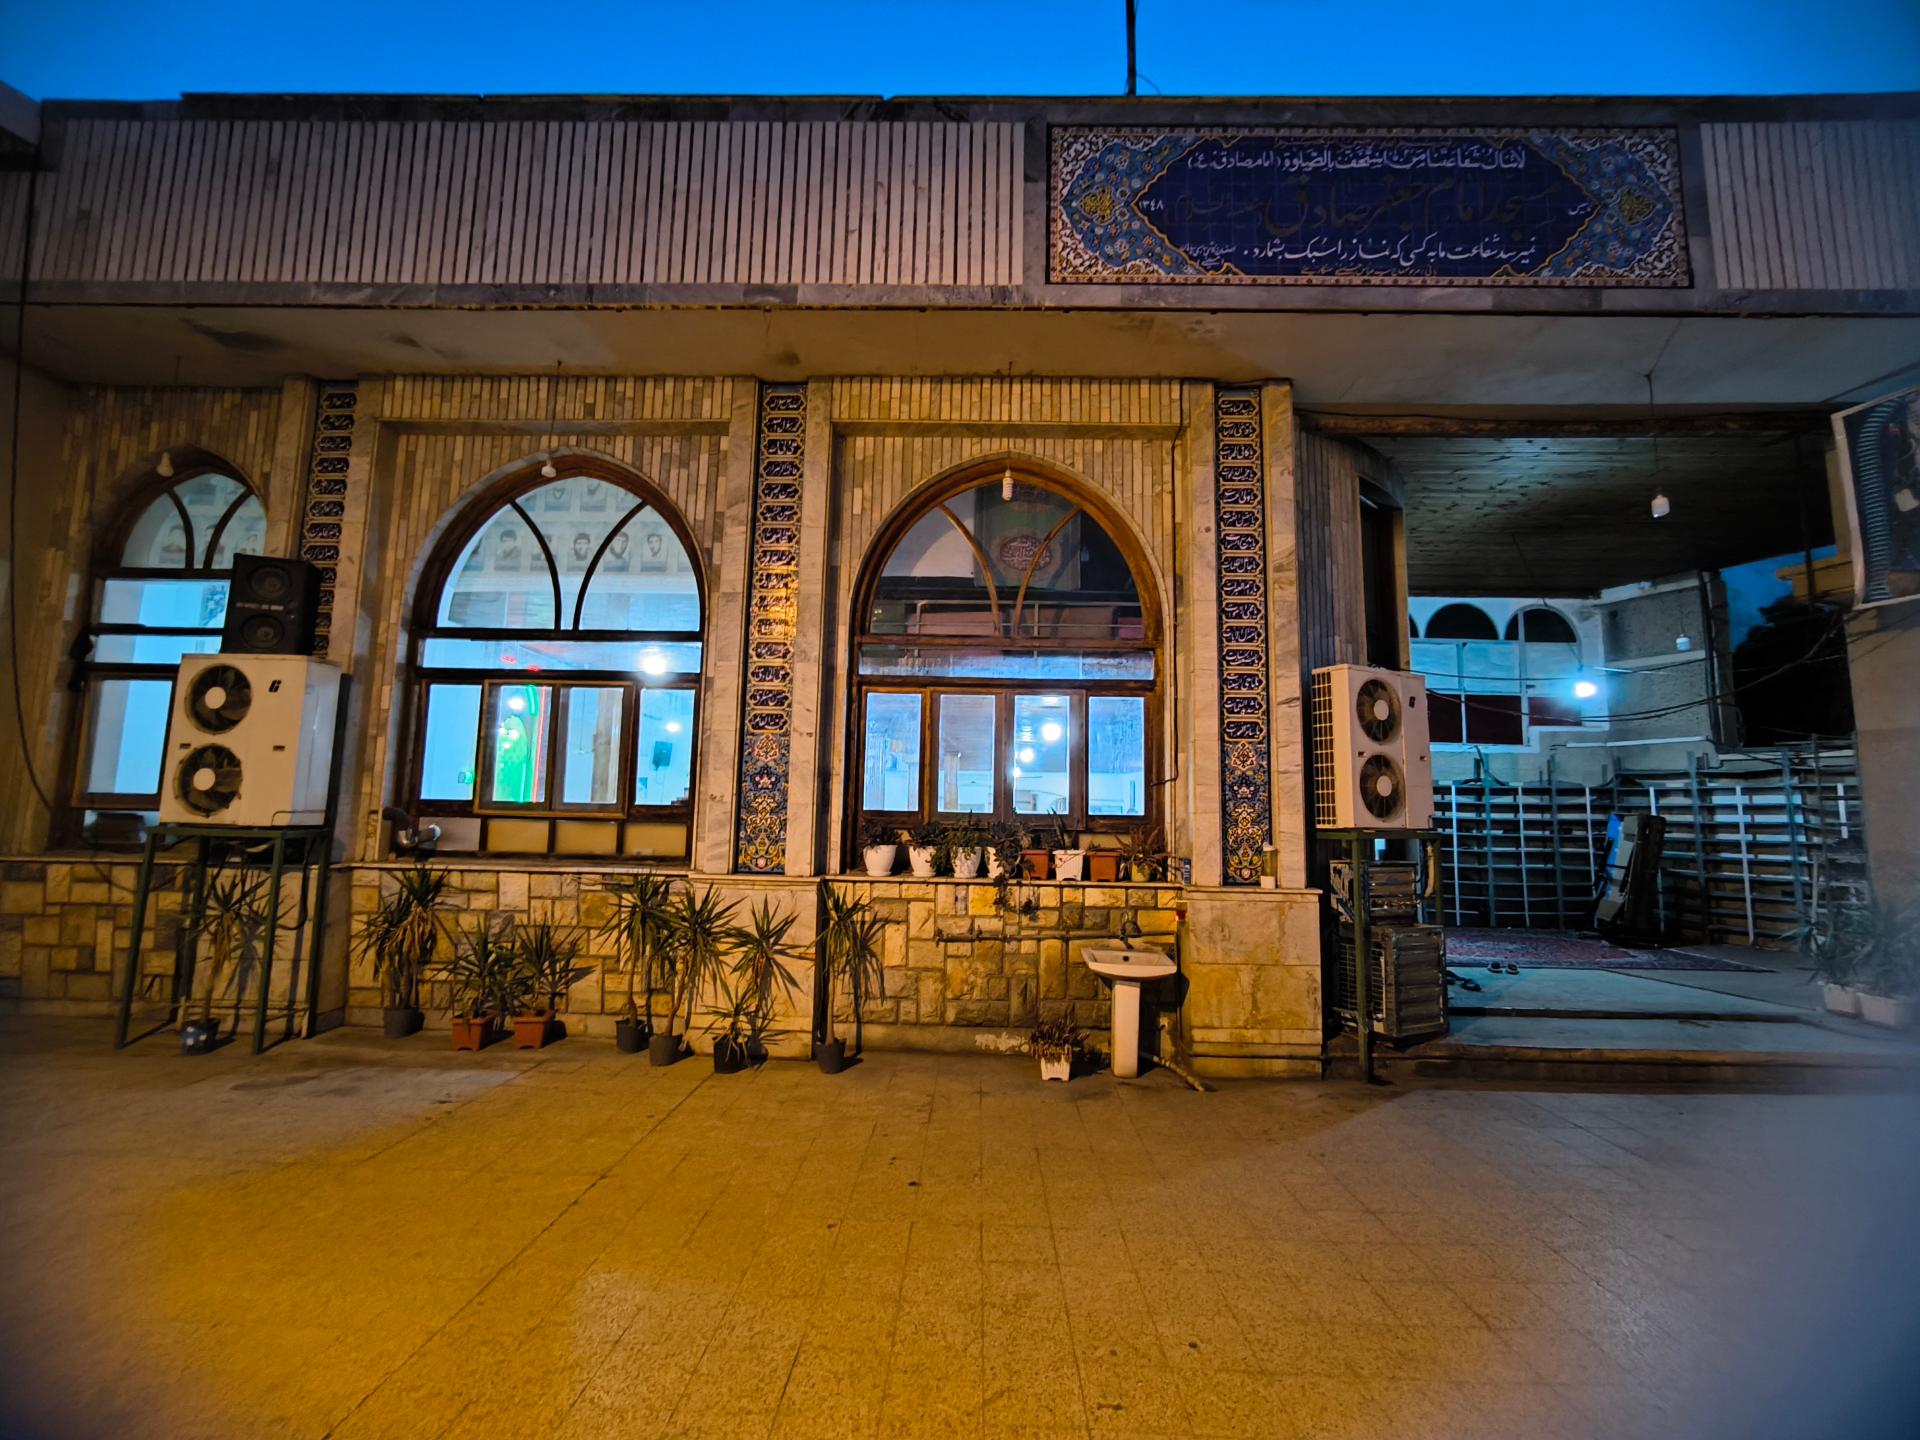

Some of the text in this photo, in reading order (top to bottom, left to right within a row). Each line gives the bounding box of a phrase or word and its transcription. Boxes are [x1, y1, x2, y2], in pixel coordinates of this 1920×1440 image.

[1427, 143, 1481, 168] شفاعتنا
[1285, 235, 1338, 262] سبک
[1338, 239, 1349, 261] را
[1349, 237, 1390, 262] نماز
[1390, 235, 1410, 260] که
[1399, 231, 1438, 267] کسی
[1427, 248, 1438, 263] به
[1438, 241, 1447, 258] ما
[1446, 233, 1500, 260] شفاعت
